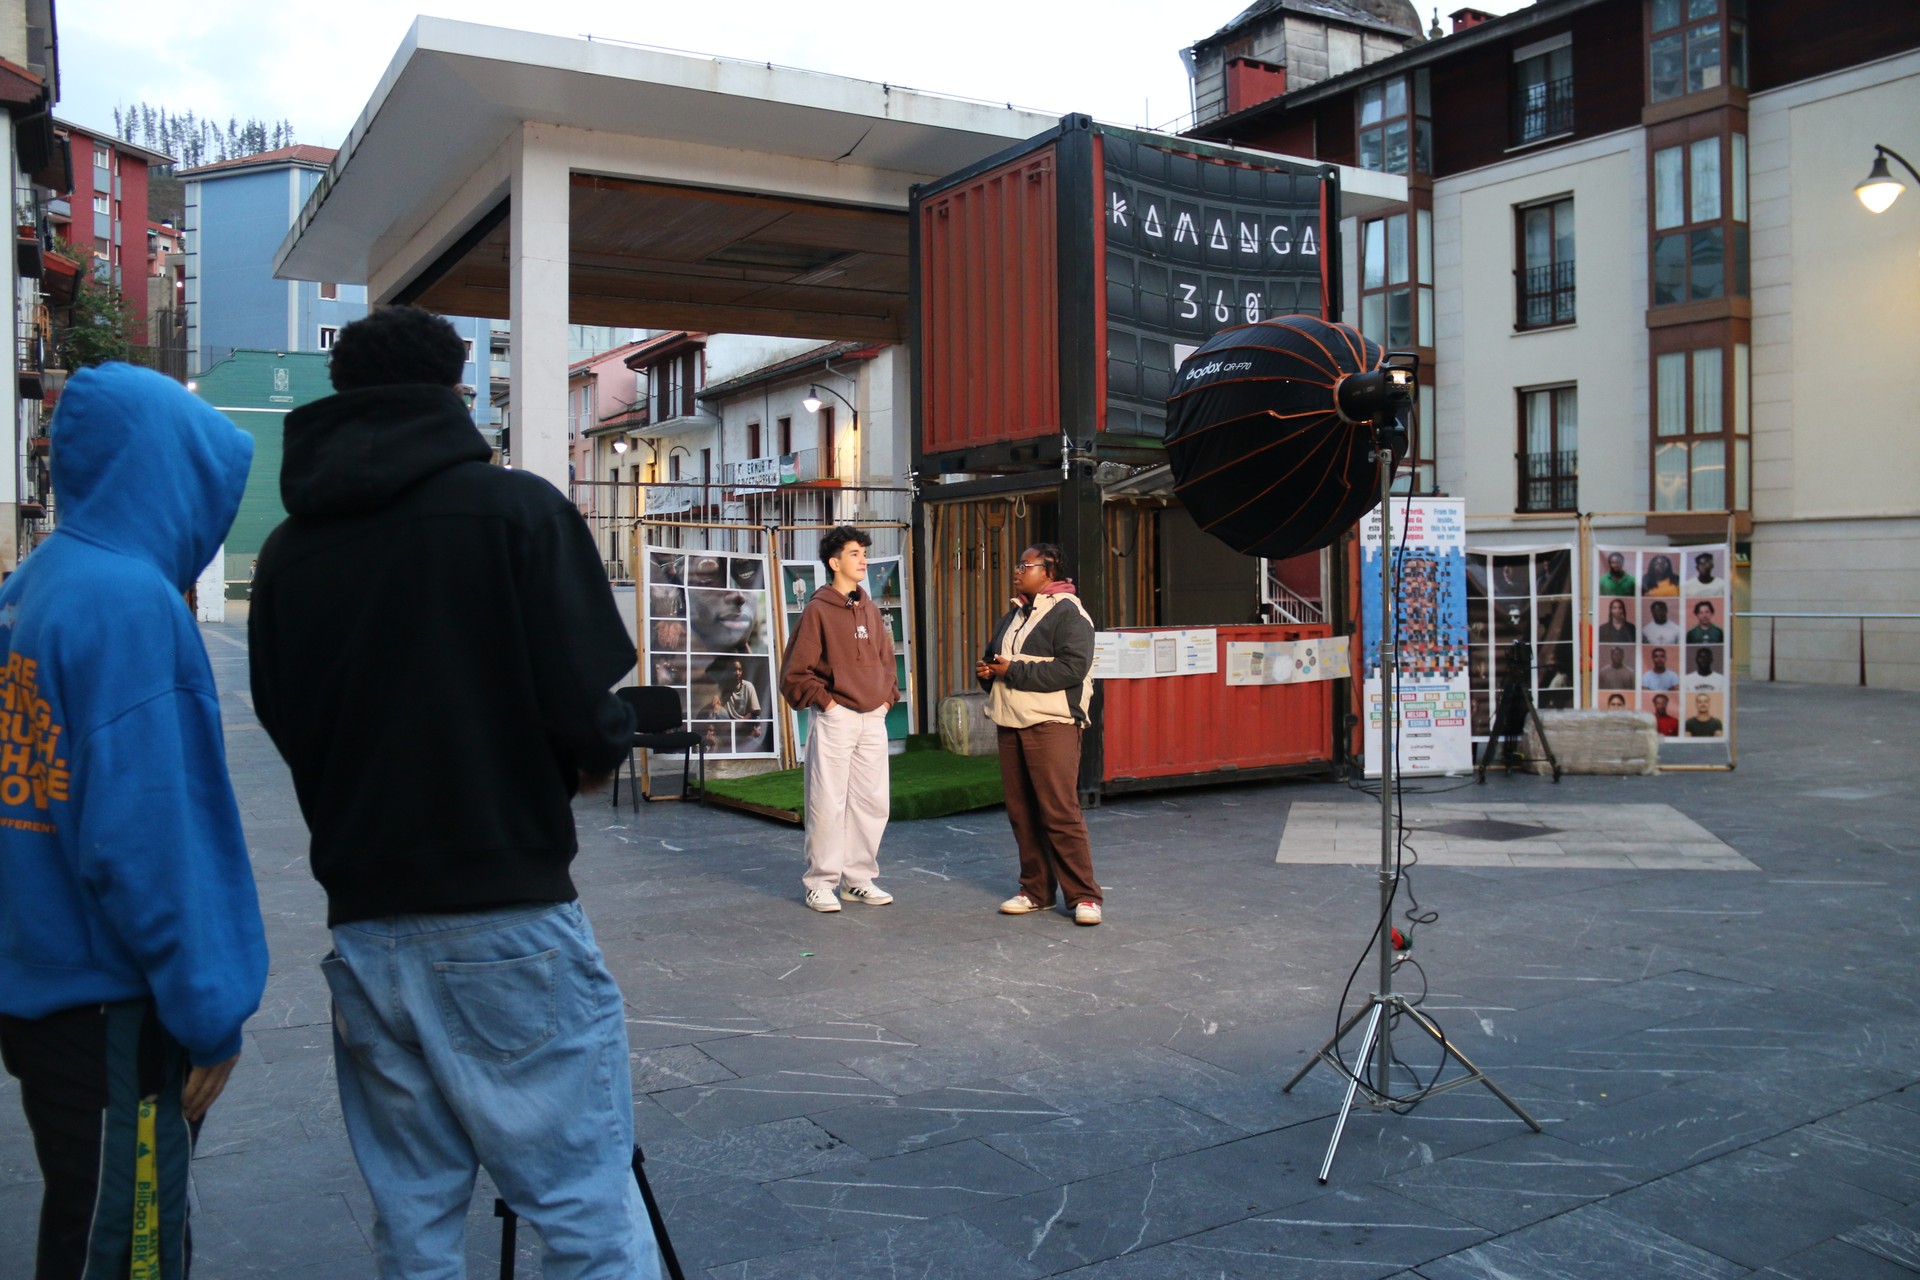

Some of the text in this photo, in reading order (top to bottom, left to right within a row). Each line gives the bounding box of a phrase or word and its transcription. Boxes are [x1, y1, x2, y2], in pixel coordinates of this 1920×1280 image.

[1112, 191, 1318, 256] KAMANGA
[135, 1181, 152, 1230] Bilbao
[133, 1234, 149, 1263] BBK
